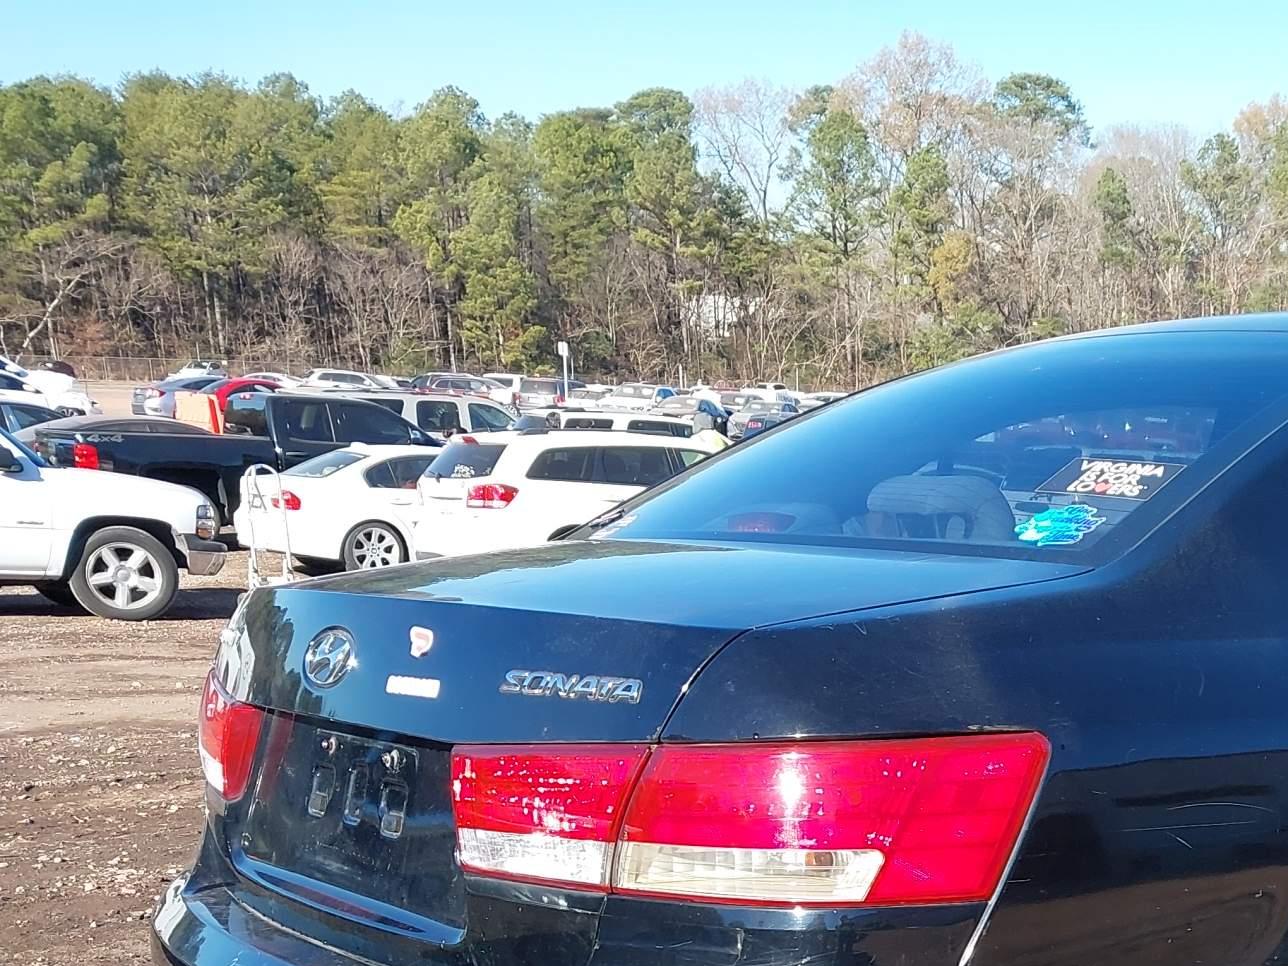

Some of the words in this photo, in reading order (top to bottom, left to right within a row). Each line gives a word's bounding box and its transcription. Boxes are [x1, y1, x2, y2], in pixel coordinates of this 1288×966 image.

[86, 432, 125, 443] 4x4
[1081, 460, 1164, 477] VIRGINIA
[1078, 471, 1100, 482] IS
[1097, 472, 1142, 485] FOR
[499, 669, 643, 704] SONATA
